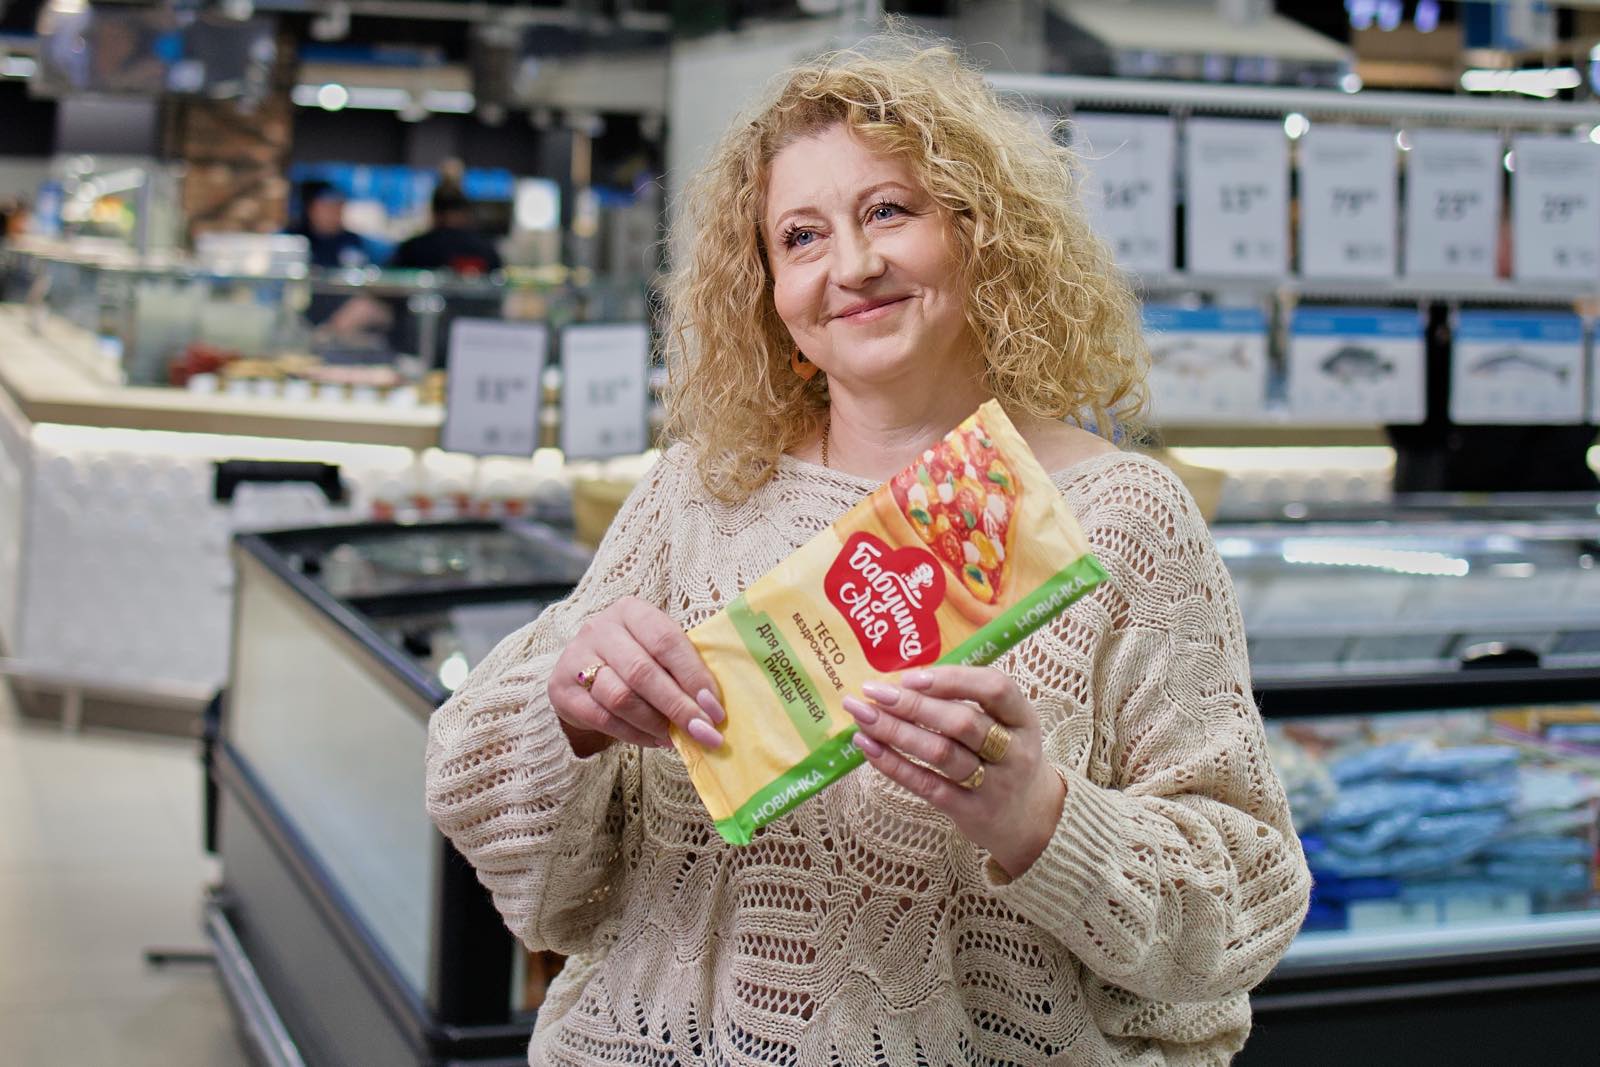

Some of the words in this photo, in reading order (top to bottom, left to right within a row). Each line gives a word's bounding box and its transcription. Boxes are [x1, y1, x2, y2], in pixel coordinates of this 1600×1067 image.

[839, 582, 889, 648] Аня
[849, 541, 922, 661] Бабушка
[1015, 576, 1087, 631] НОВИНКА
[792, 612, 844, 691] БЕЗДРОЖЖЕВОЕ
[814, 620, 845, 665] ТЕСТО
[756, 623, 779, 650] ДЛЯ
[771, 649, 825, 723] ДОМАШНЕЙ
[764, 656, 797, 704] ПИЦЦЫ
[752, 769, 824, 824] НОВИНКА
